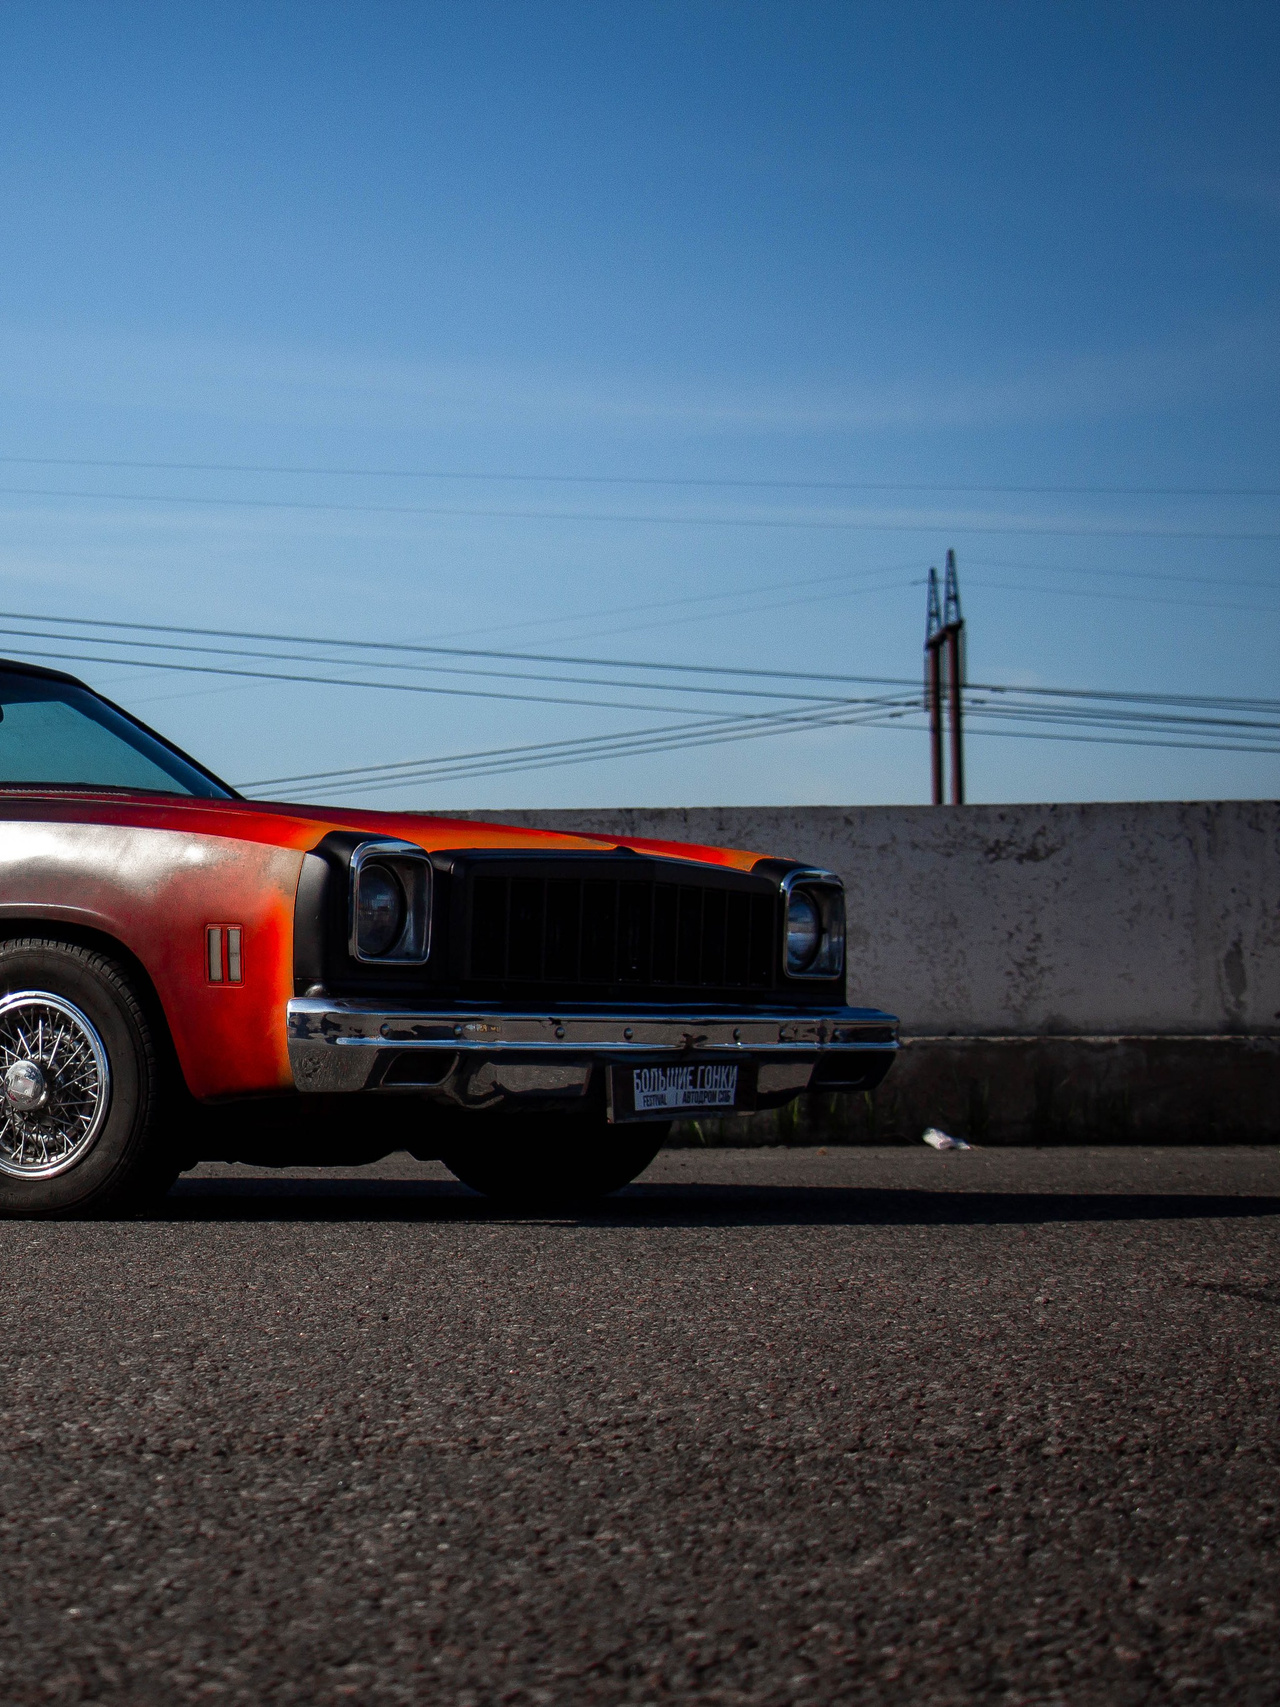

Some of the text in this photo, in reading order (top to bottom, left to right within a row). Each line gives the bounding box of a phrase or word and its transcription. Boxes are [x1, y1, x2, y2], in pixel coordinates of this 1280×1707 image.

[633, 1065, 738, 1093] БОЛЬШИЕ ГОНКИ
[643, 1094, 667, 1107] FESTIVAL
[682, 1091, 717, 1105] АВТОДРОМ
